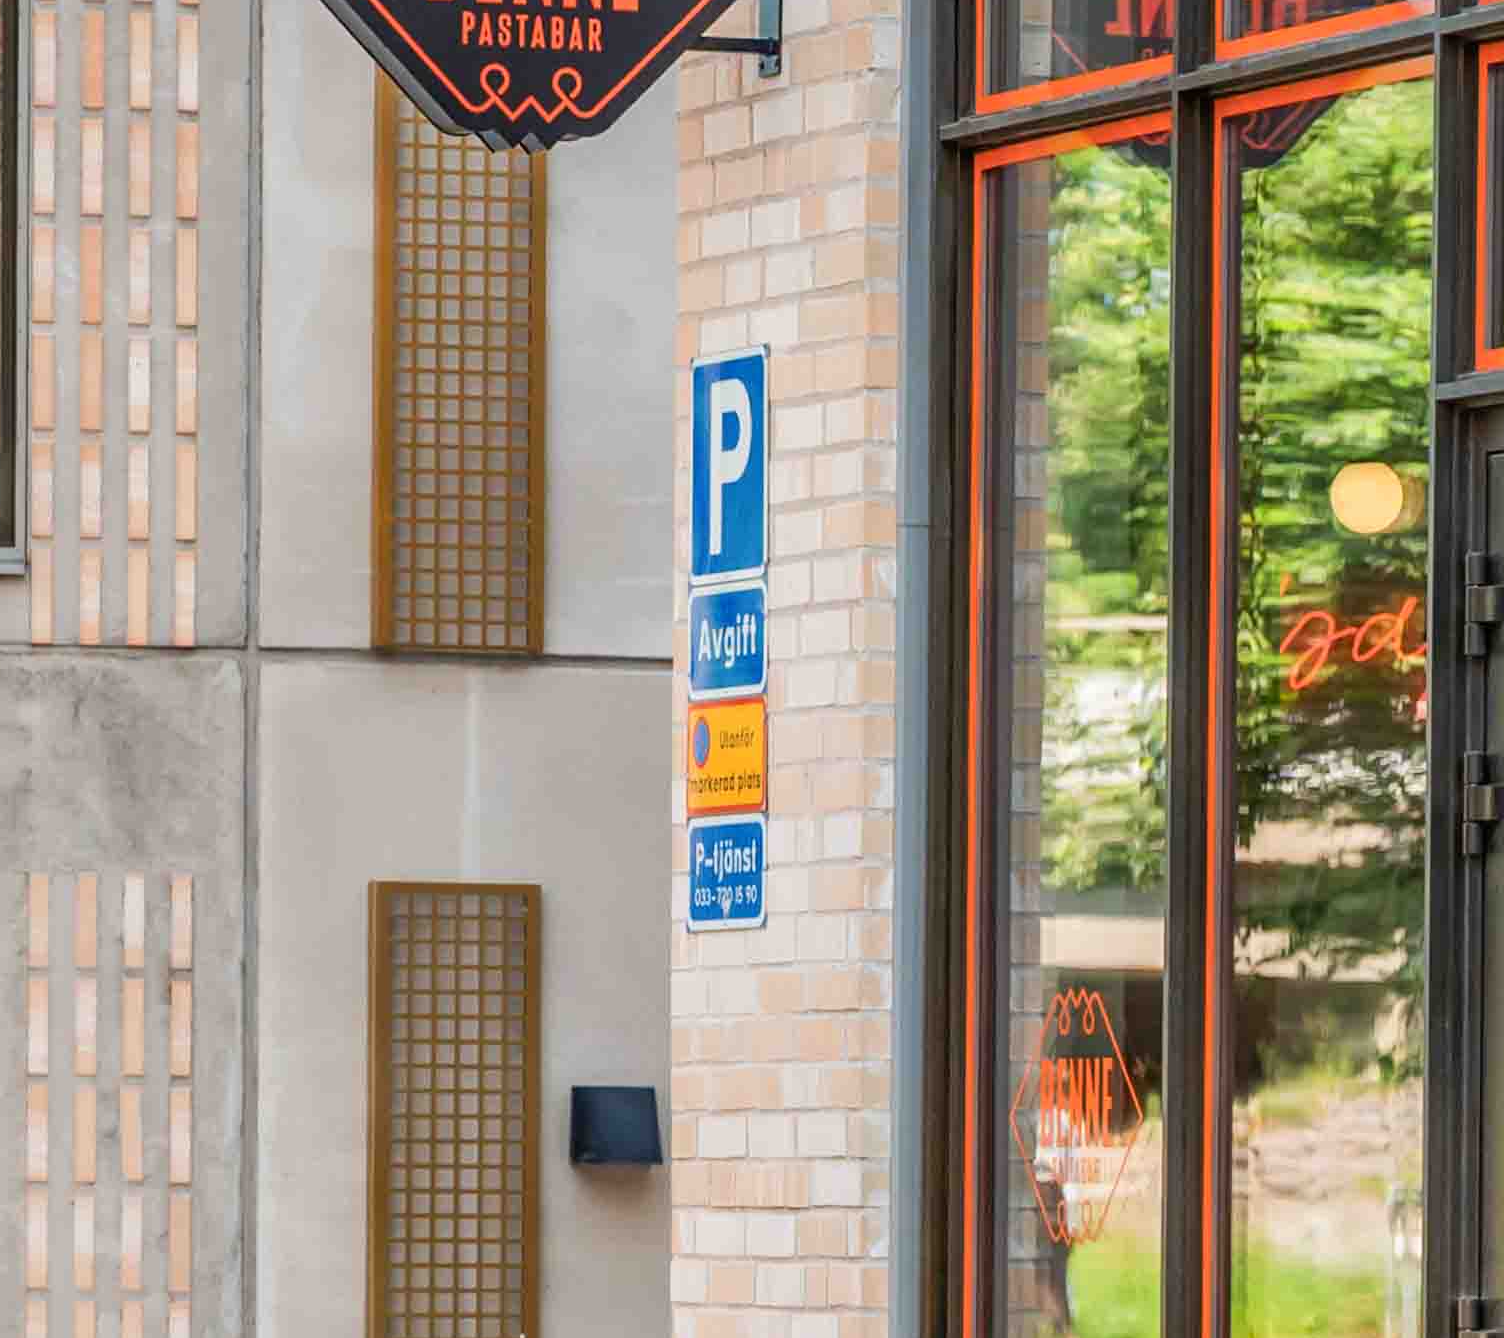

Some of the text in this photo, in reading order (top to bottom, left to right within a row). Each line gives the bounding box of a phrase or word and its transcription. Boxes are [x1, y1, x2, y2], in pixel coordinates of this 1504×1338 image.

[460, 10, 603, 53] PASTABAR
[709, 377, 753, 556] P
[698, 613, 757, 668] Avgift
[737, 768, 761, 797] plats
[695, 838, 756, 883] P-tjänst
[1040, 1057, 1113, 1147] BENNE
